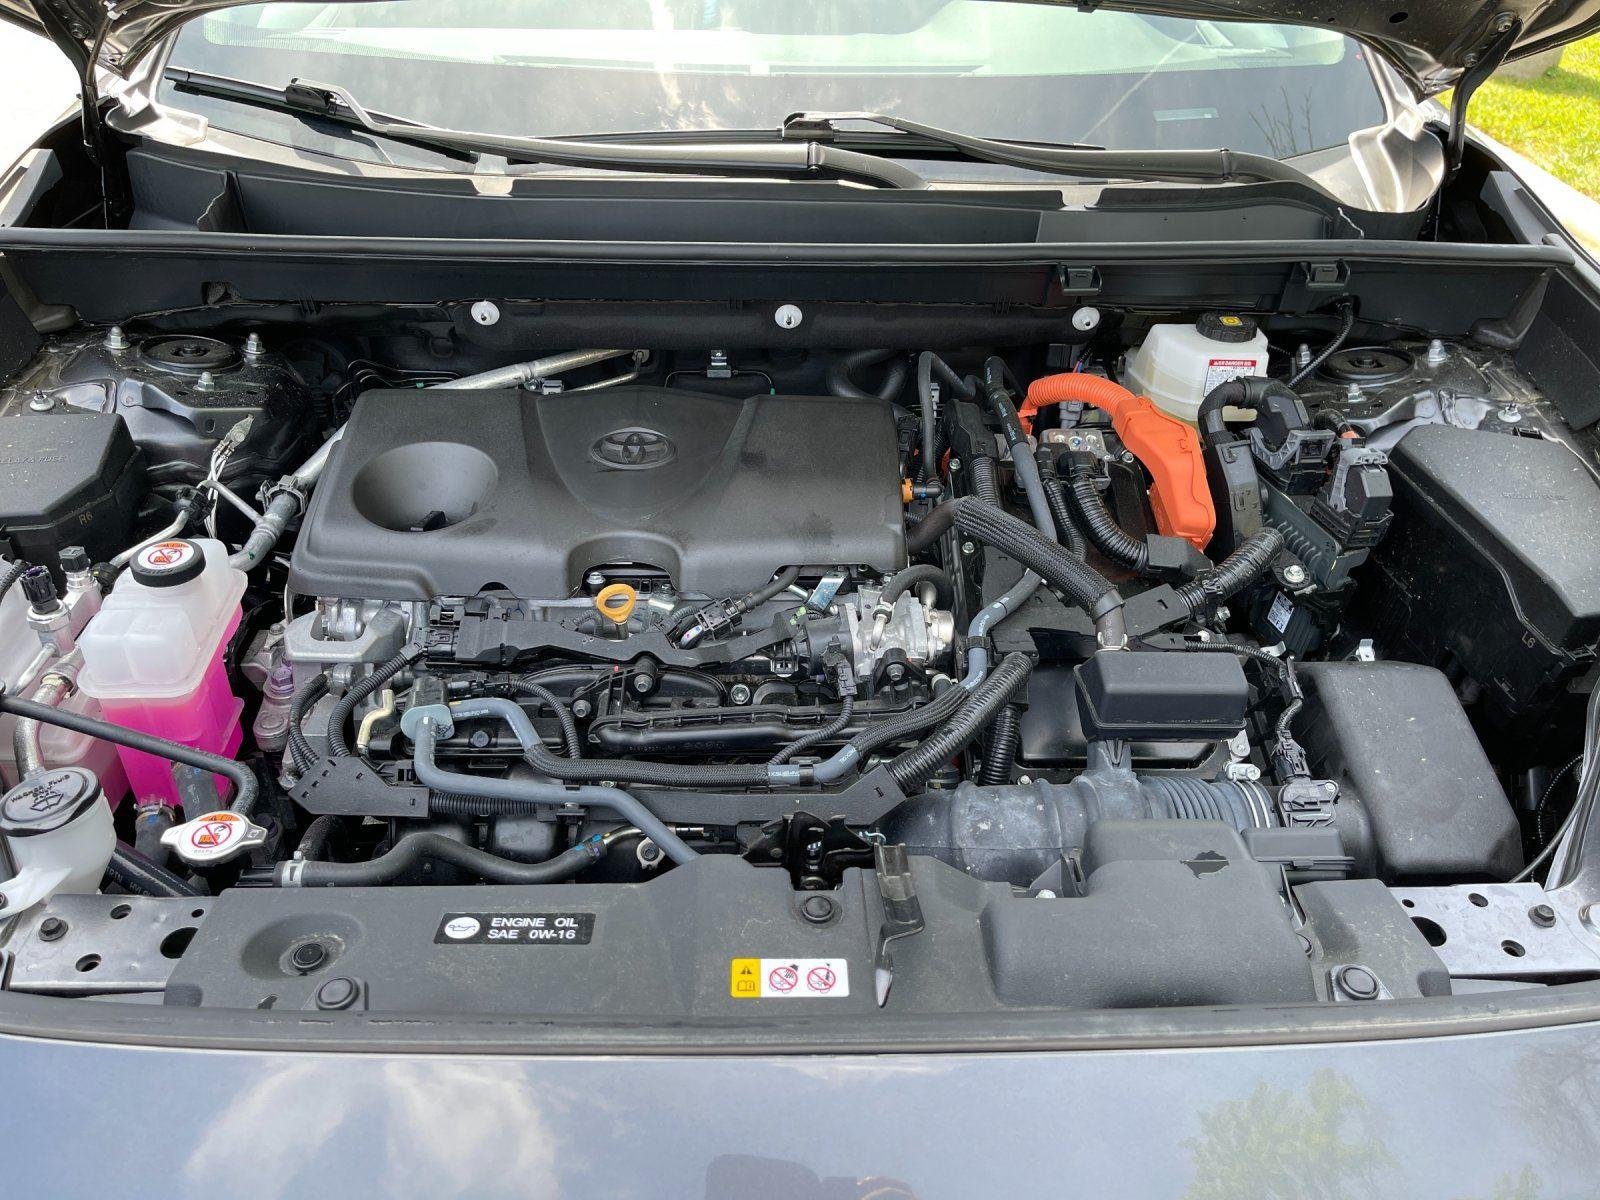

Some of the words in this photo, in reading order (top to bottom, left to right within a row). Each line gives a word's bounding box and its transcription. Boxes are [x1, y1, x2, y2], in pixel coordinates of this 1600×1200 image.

[491, 917, 546, 928] ENGINE
[554, 917, 579, 928] OIL
[487, 929, 519, 939] SAE
[529, 929, 576, 939] 0W-16
